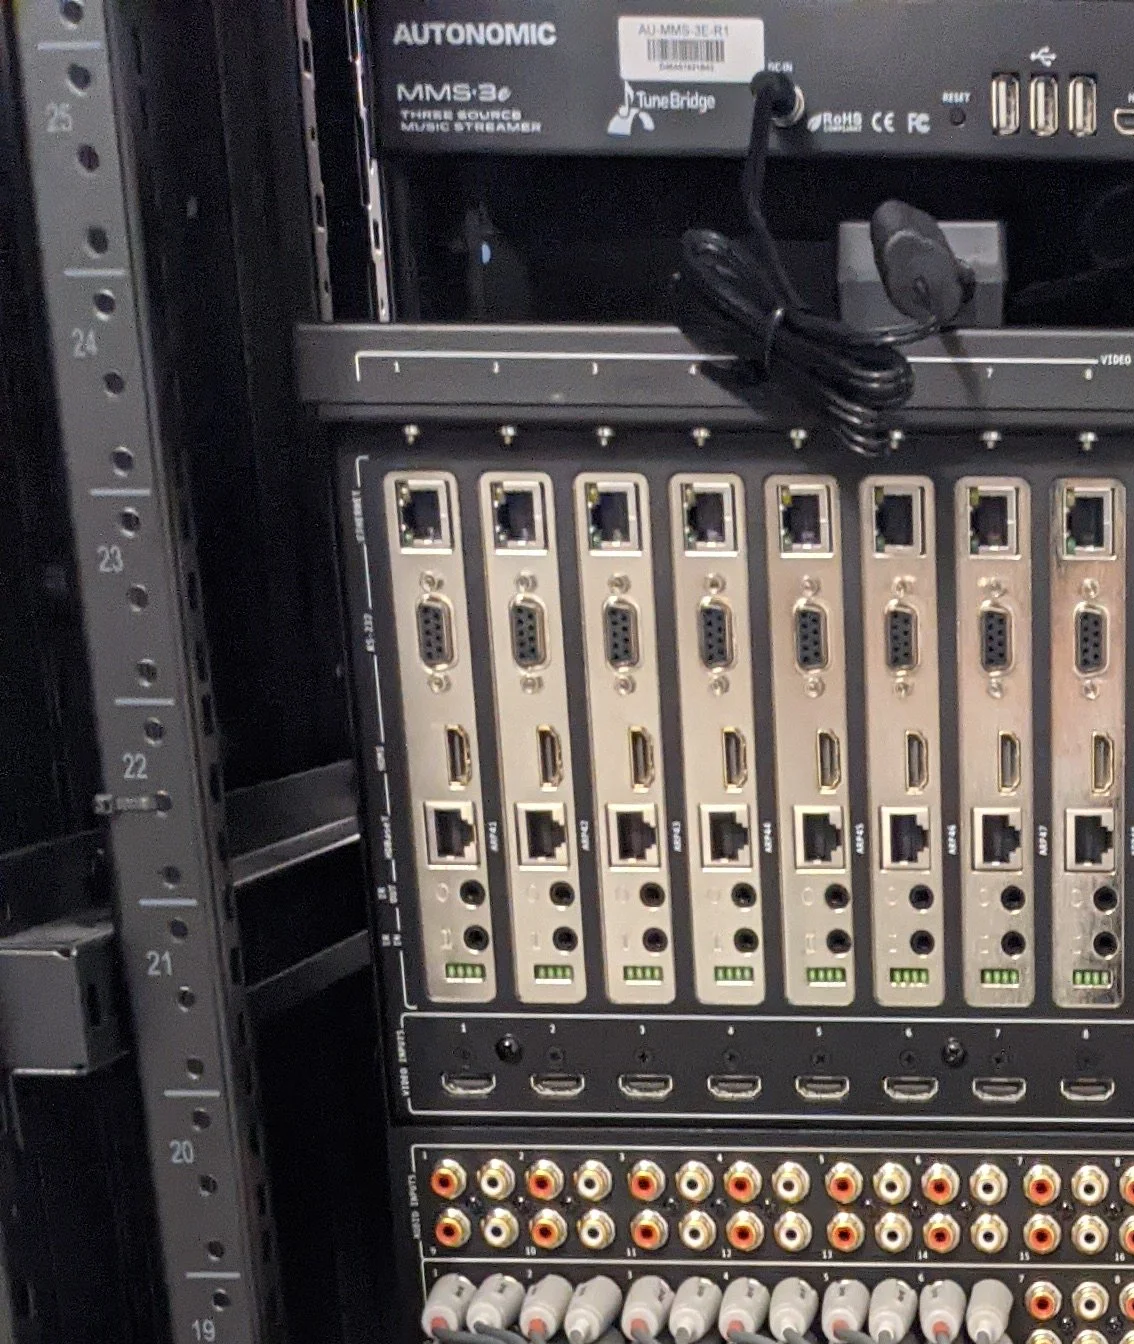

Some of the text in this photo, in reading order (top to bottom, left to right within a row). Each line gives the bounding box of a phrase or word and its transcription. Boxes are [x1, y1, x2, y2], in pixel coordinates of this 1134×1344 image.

[393, 21, 557, 46] AUTONOMIC
[638, 23, 729, 37] AU-MMS-3E-R1
[635, 90, 716, 113] TuneBridge
[47, 103, 72, 132] 25
[457, 108, 522, 121] SOURCE
[400, 121, 542, 134] MUSIC STREAMER
[72, 328, 97, 357] 24
[1101, 354, 1131, 366] VIDEO
[97, 545, 123, 572] 23
[123, 753, 147, 779] 22
[147, 951, 171, 975] 21
[461, 1022, 467, 1033] 1
[727, 1026, 735, 1035] 4
[905, 1027, 913, 1038] 6
[995, 1028, 1001, 1038] 7
[170, 1140, 194, 1163] 20
[192, 1319, 215, 1341] 19
